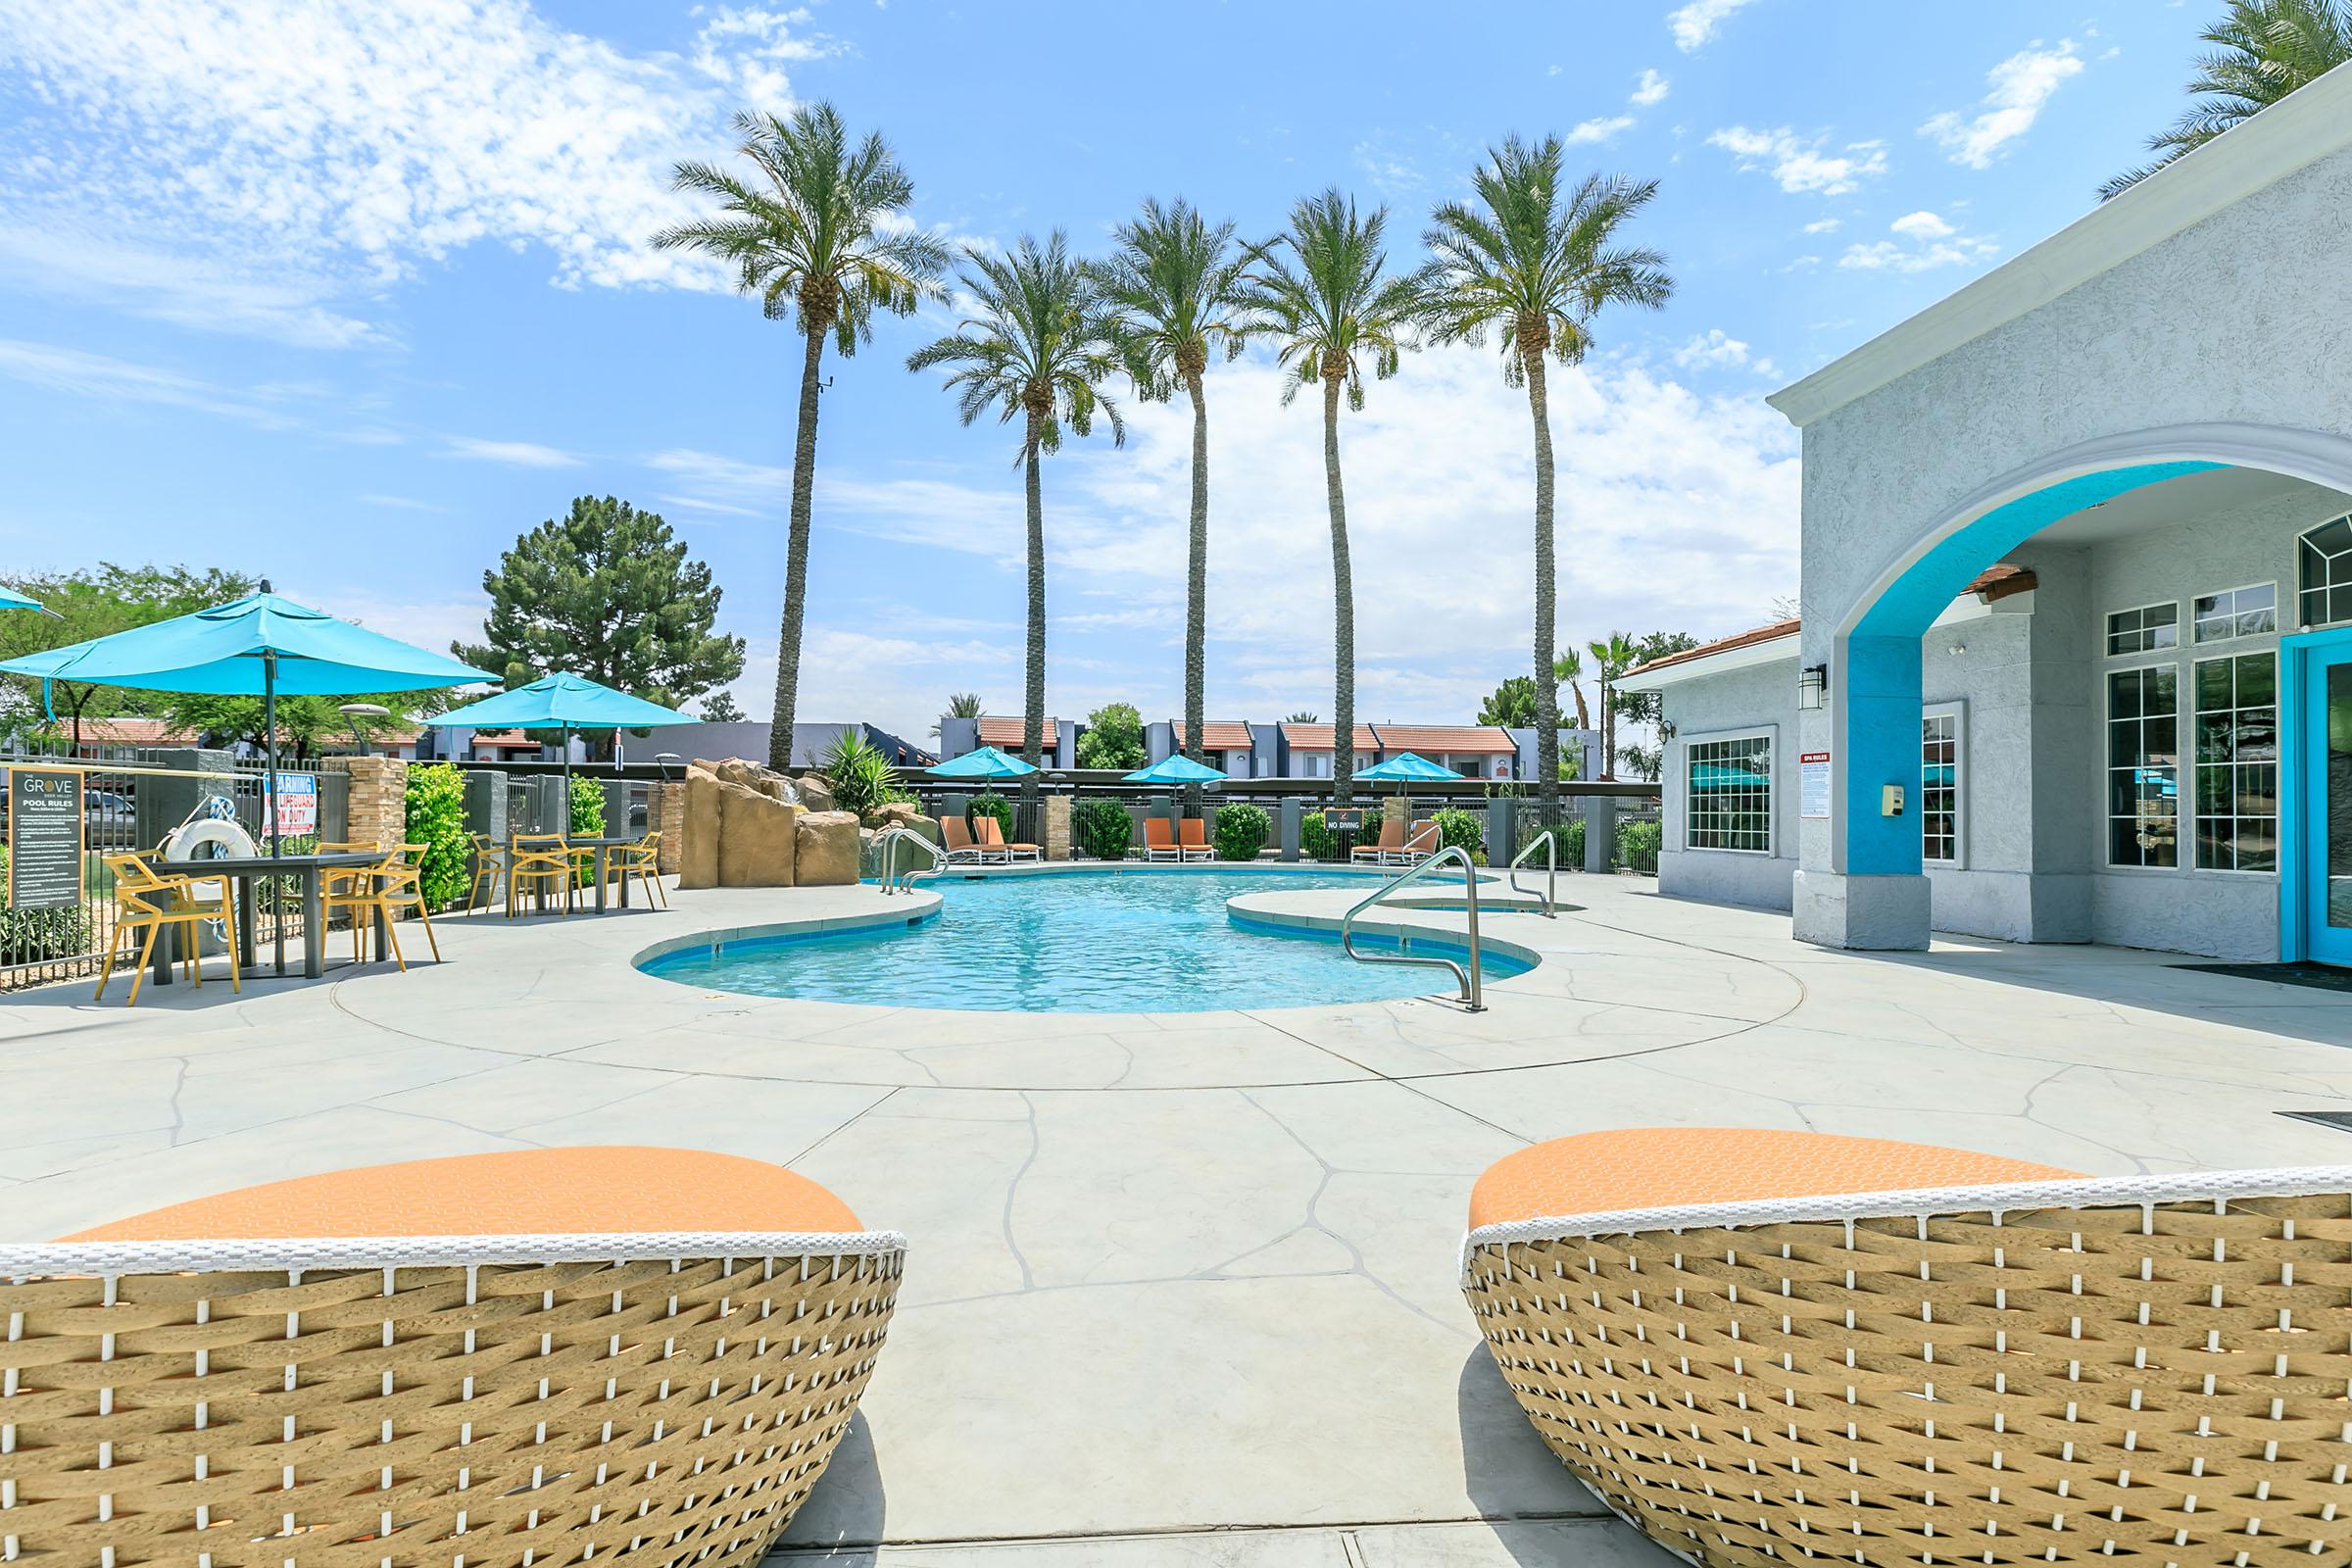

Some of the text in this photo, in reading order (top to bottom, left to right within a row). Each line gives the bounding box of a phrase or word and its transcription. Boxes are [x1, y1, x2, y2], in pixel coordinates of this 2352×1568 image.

[24, 779, 73, 793] GROVE
[276, 775, 312, 793] ARNING
[280, 794, 313, 808] LIFEGUARD
[289, 809, 306, 822] DUTY
